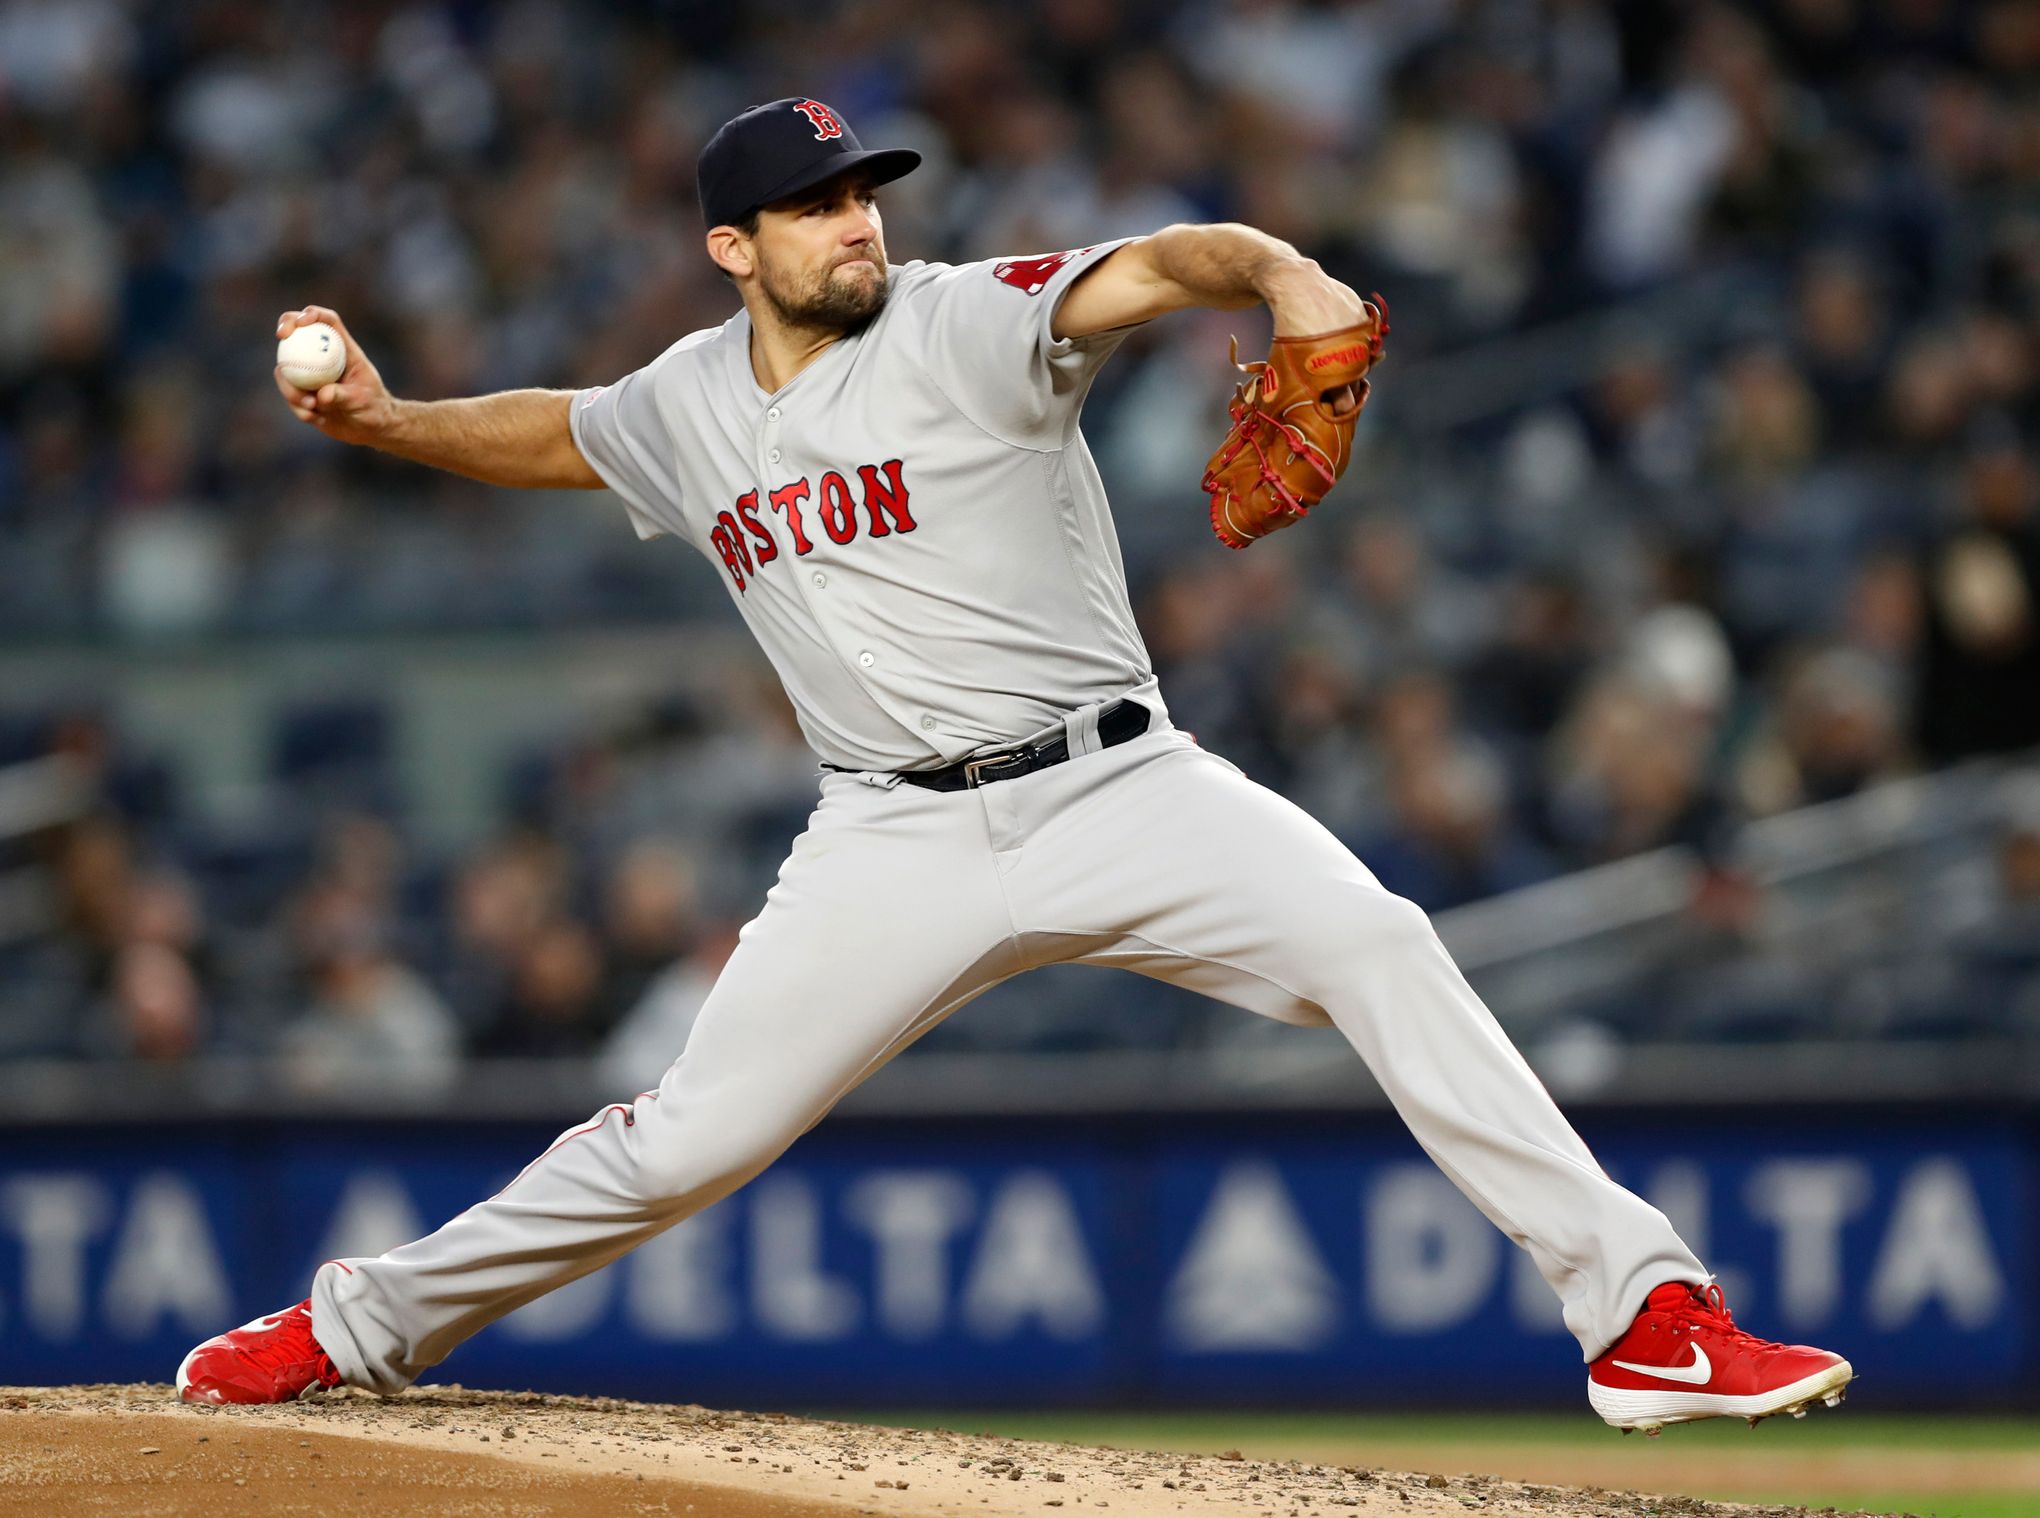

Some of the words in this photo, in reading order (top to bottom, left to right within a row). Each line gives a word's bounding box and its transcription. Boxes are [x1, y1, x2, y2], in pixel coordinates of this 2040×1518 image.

[793, 100, 842, 141] B
[711, 459, 918, 598] BOSTON
[1364, 1155, 2003, 1335] DLTA
